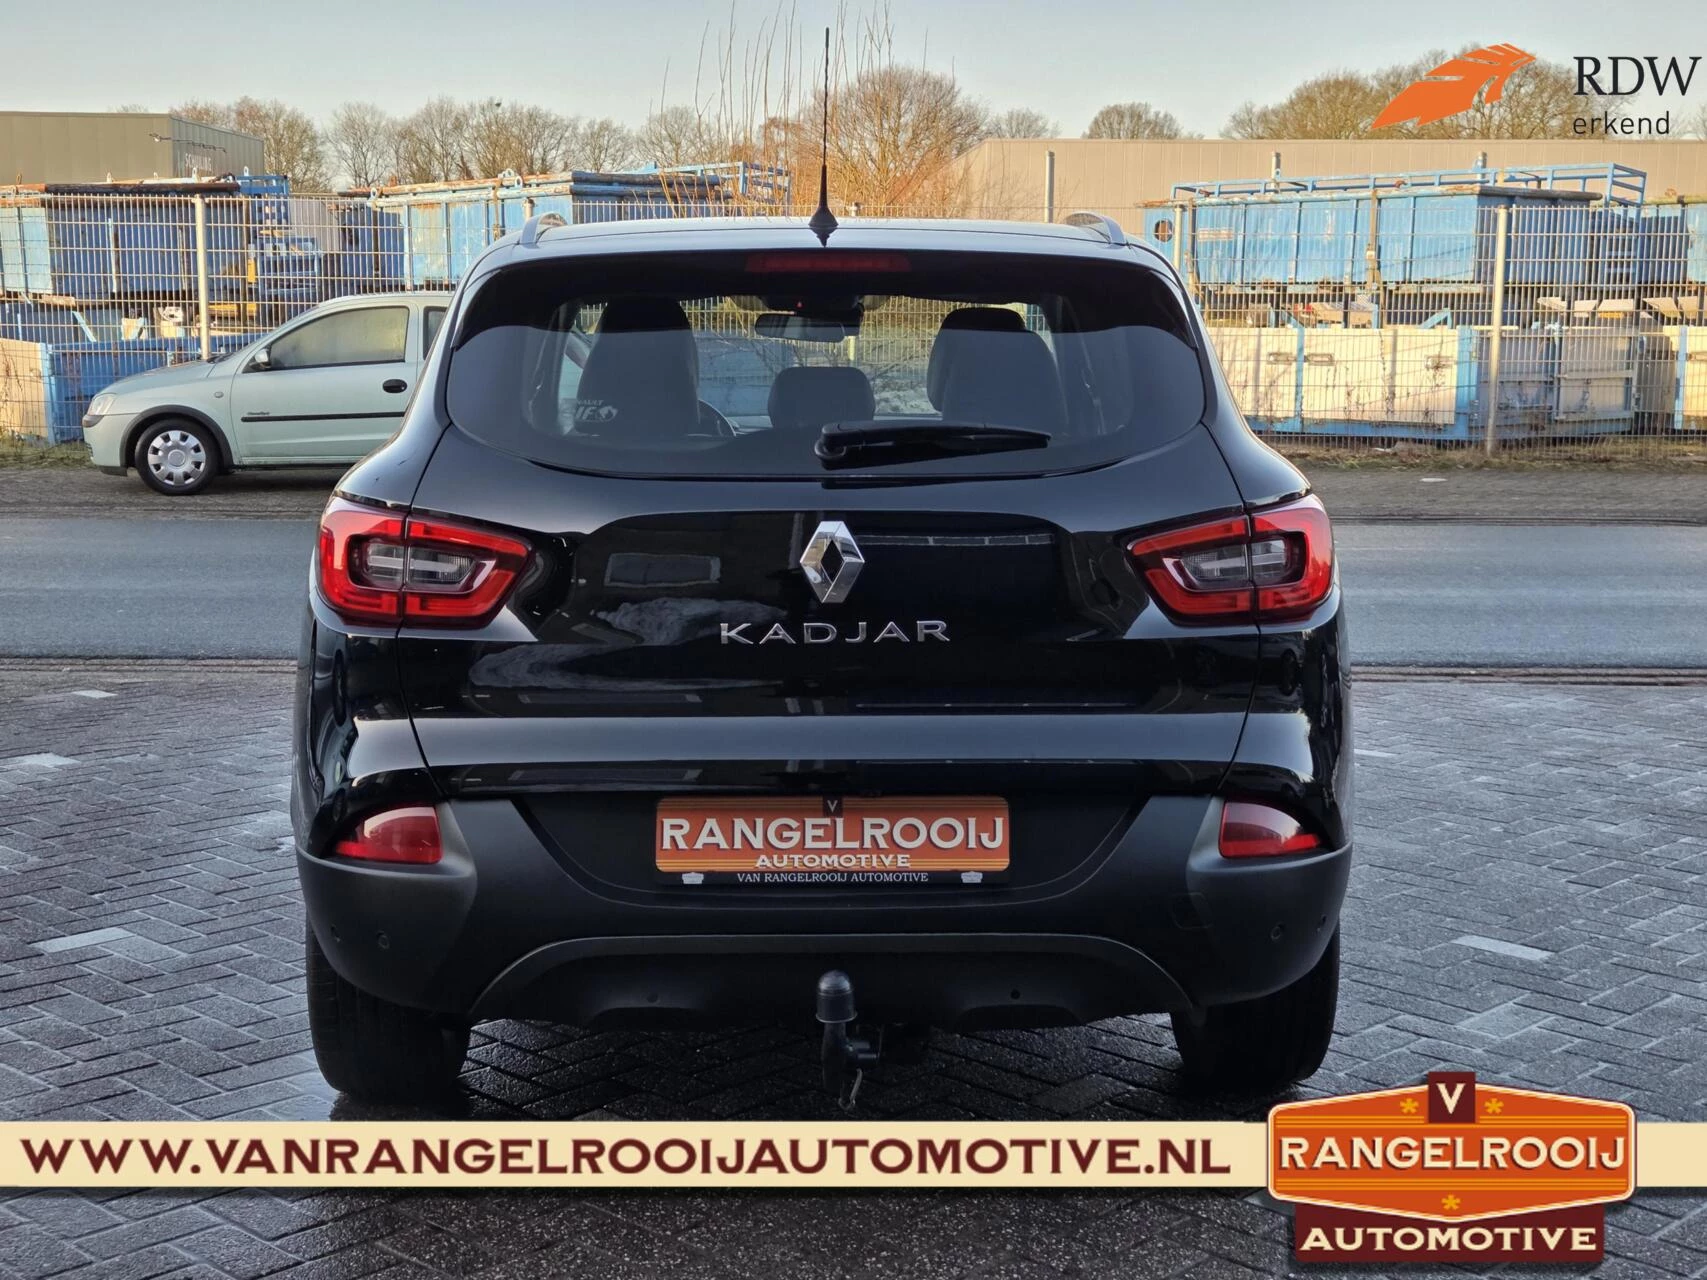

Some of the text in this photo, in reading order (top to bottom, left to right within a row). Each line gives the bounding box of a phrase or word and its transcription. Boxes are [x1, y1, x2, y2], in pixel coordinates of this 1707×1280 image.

[720, 620, 950, 645] KADJAR
[826, 799, 838, 813] V
[661, 816, 1005, 850] RANGELROOIJ
[755, 854, 911, 868] AUTOMOTIVE
[737, 872, 929, 883] VAN RANGELROOIJ AUTOMOTIVE
